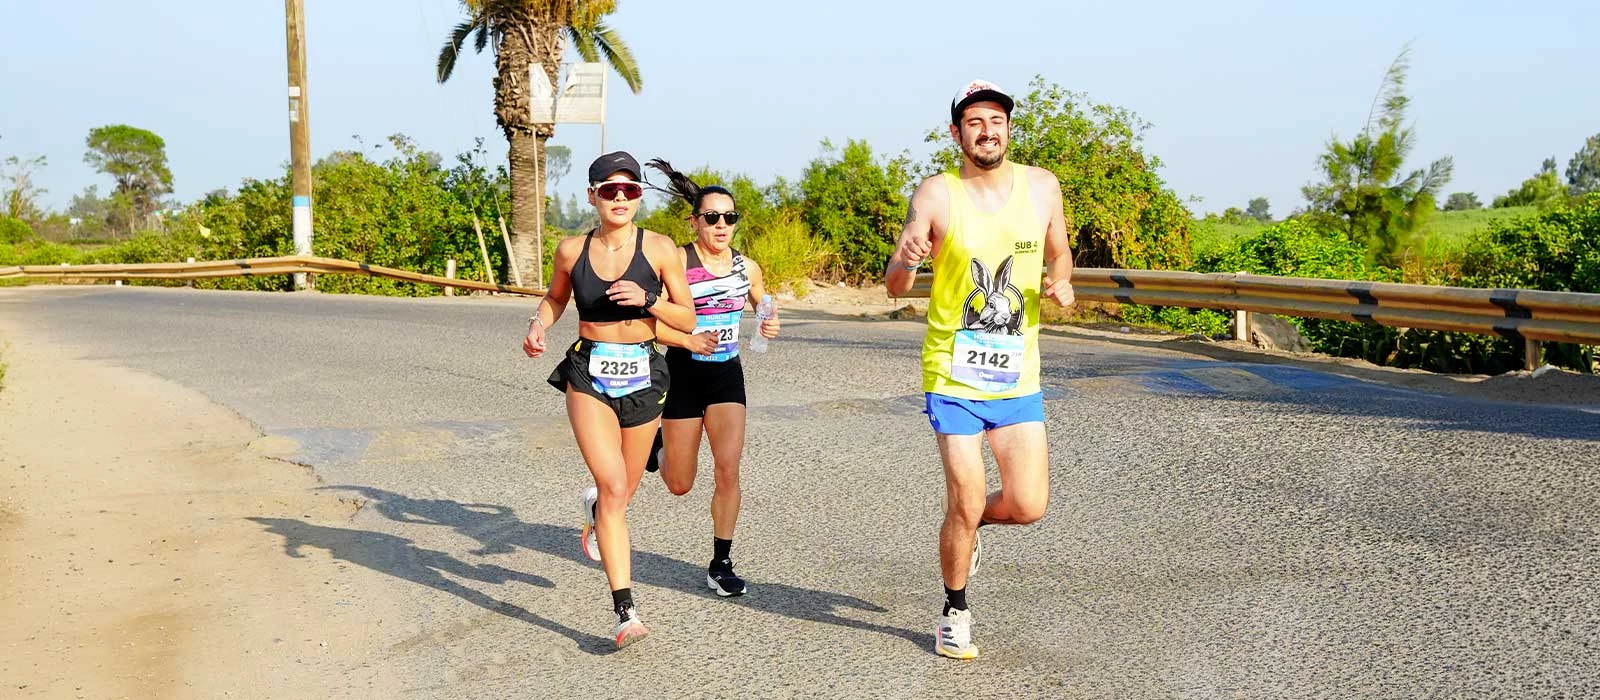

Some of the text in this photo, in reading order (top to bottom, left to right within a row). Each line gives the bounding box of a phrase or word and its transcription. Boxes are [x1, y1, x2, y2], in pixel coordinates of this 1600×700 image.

[1015, 241, 1032, 250] SUB
[966, 350, 1010, 369] 2142
[600, 360, 639, 376] 2325
